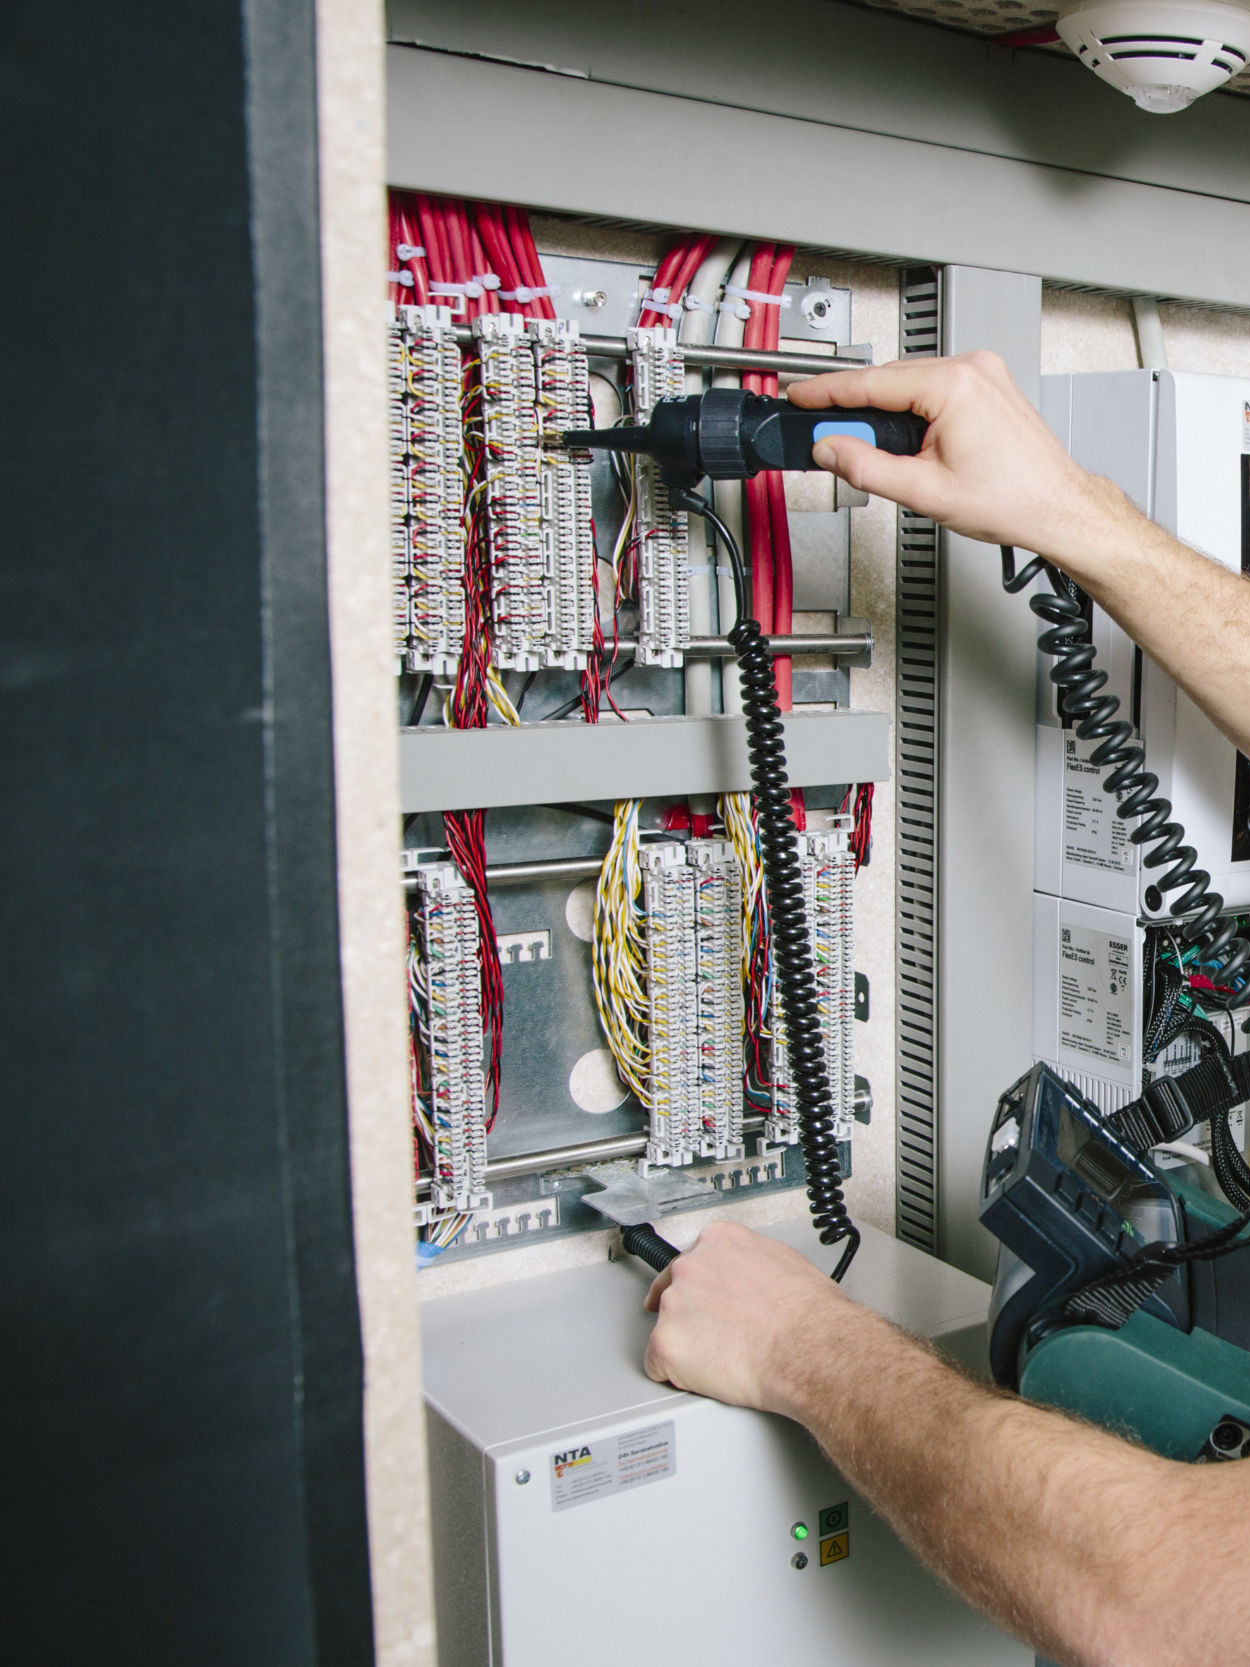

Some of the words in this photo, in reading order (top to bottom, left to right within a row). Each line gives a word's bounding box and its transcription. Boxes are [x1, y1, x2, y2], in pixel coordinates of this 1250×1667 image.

[1083, 766, 1101, 775] control
[1109, 941, 1128, 951] ESSER
[1079, 955, 1095, 965] control
[554, 1446, 592, 1465] NTA
